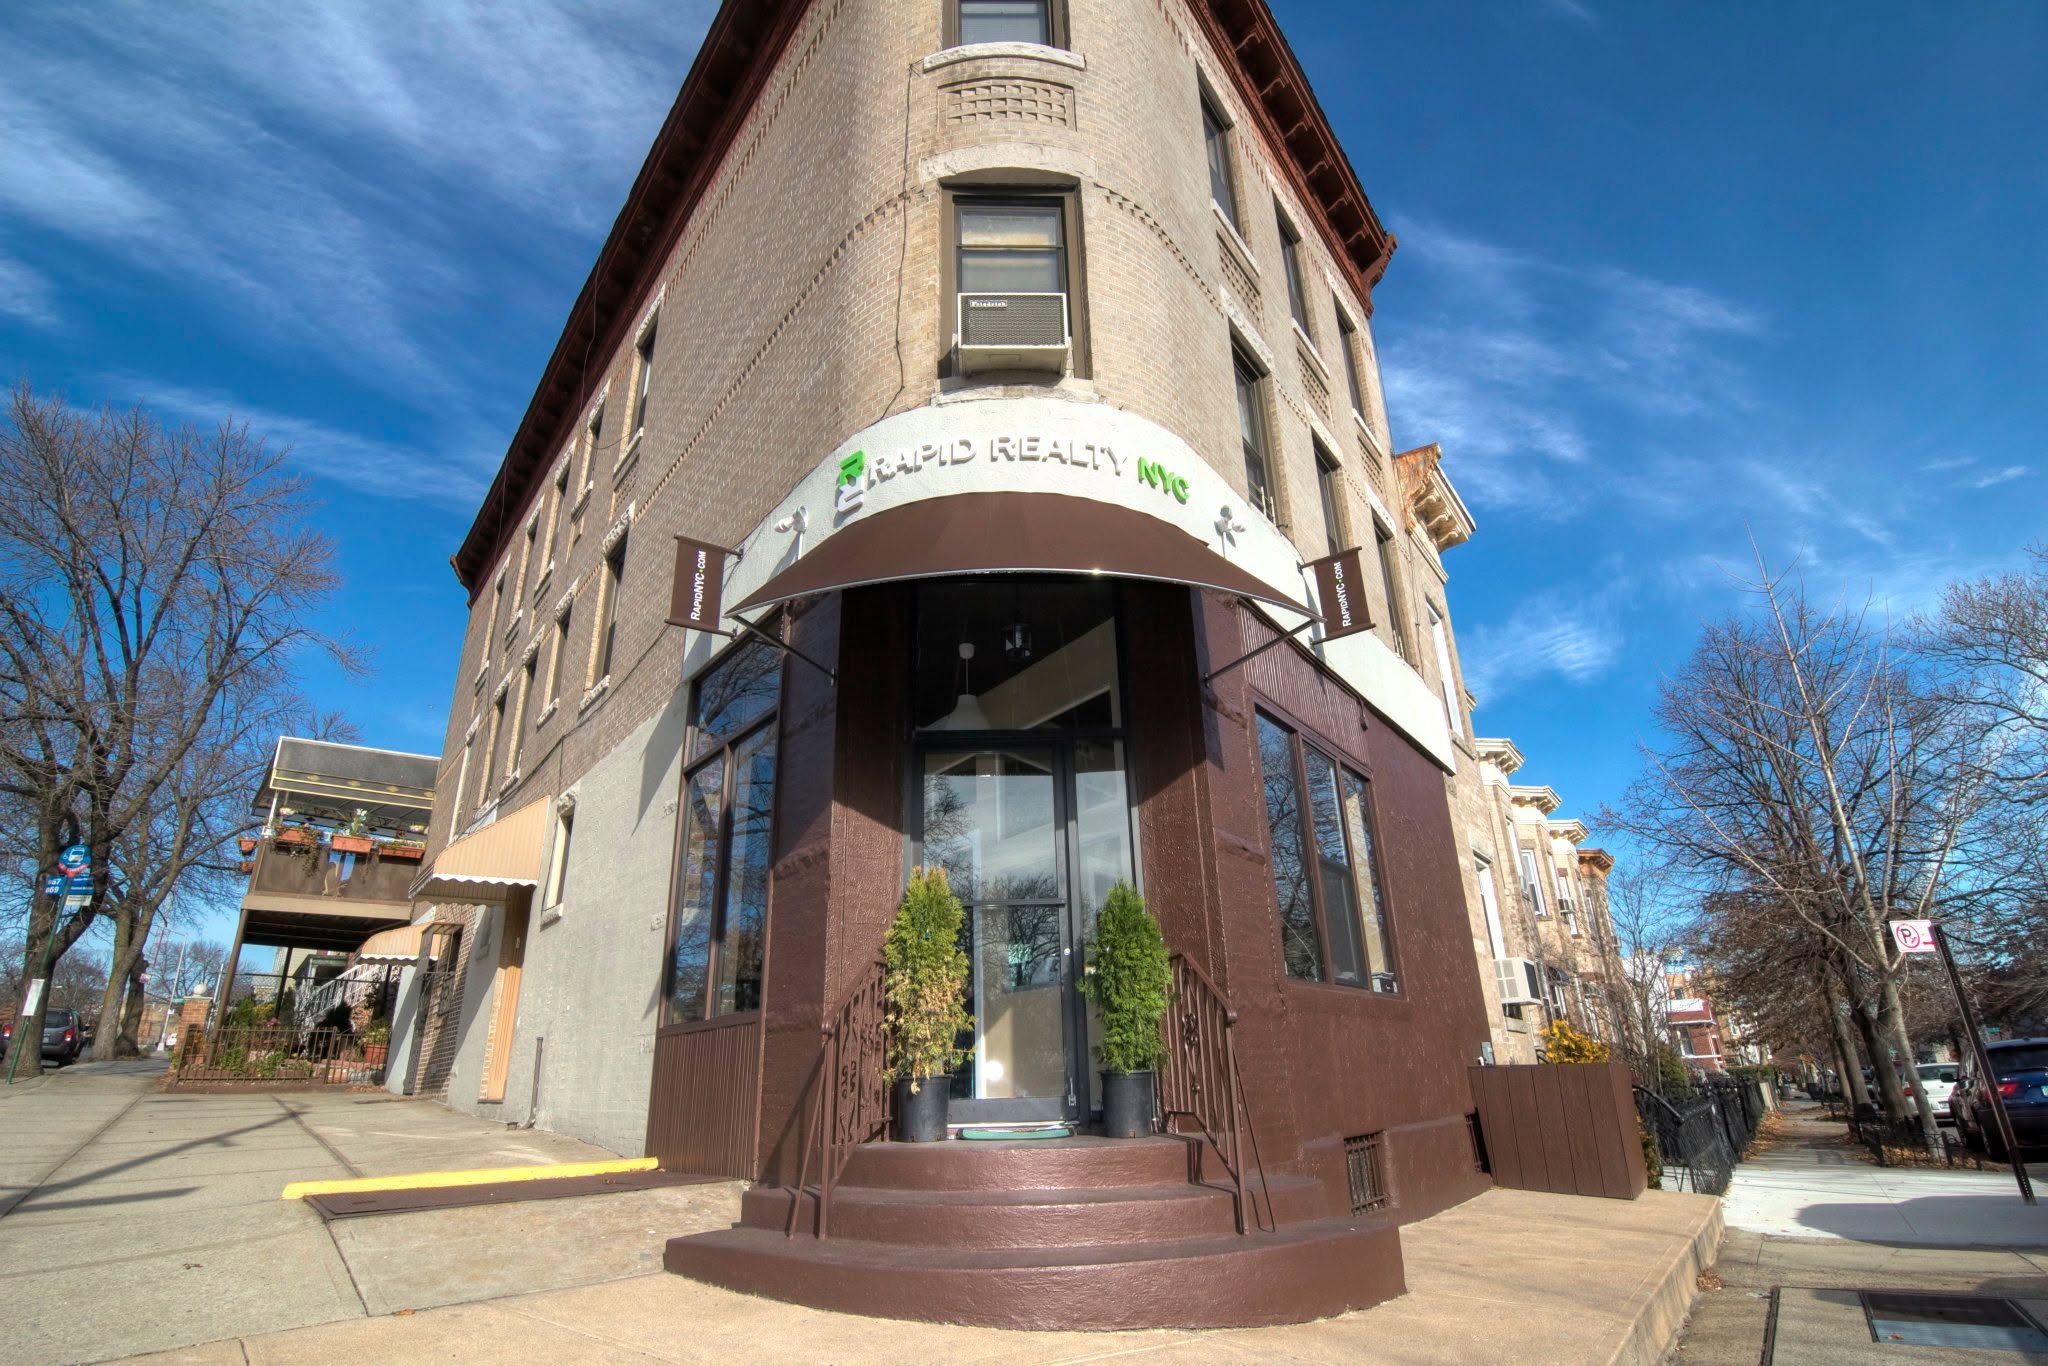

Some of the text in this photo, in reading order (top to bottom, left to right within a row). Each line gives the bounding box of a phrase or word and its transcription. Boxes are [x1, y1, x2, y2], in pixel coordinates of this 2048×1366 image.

[869, 436, 1191, 503] RAPID REALTY NYC
